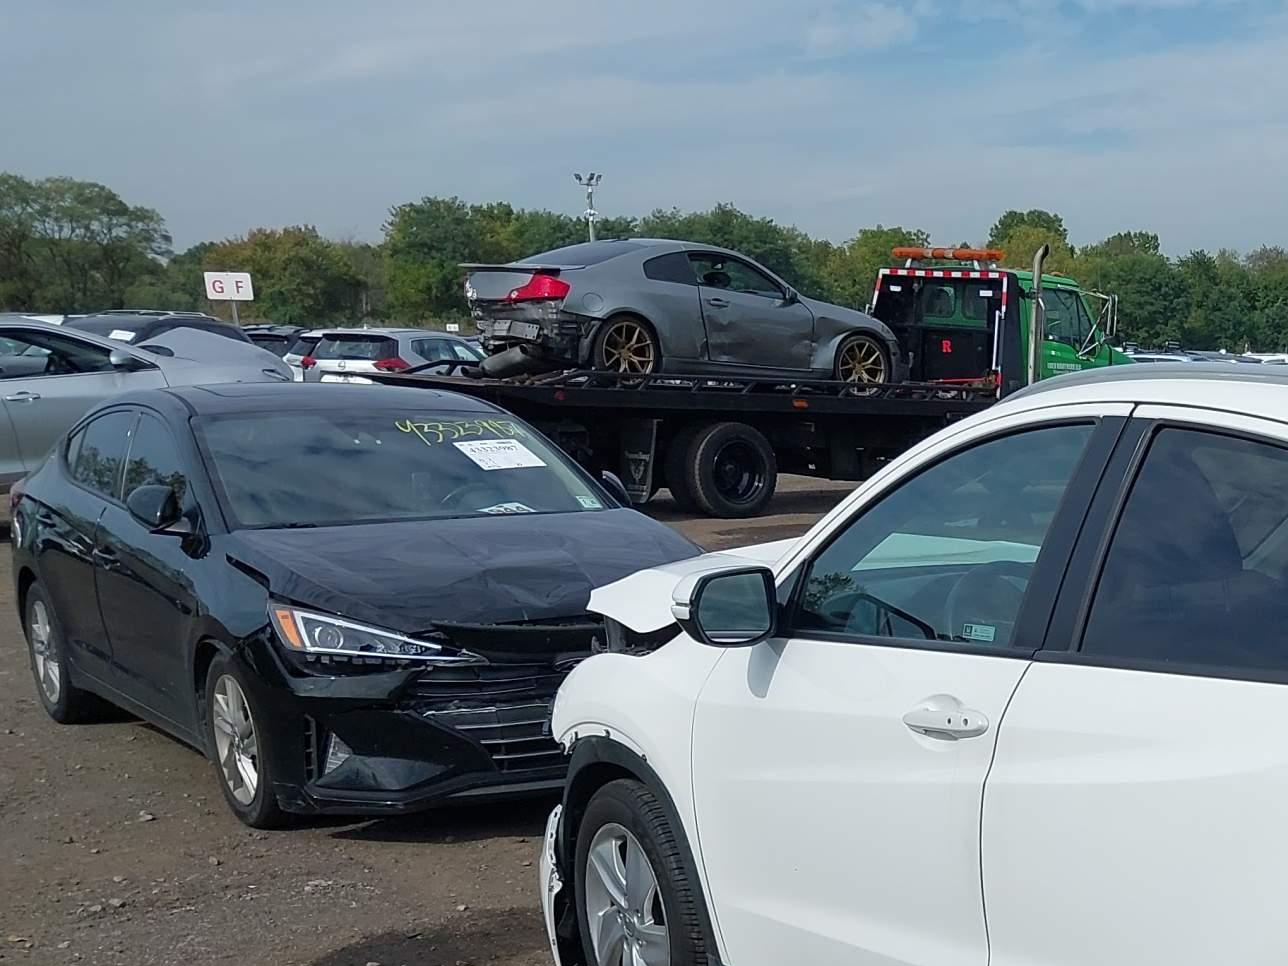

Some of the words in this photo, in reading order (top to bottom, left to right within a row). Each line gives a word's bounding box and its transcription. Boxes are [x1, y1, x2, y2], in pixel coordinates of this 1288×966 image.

[212, 279, 225, 294] G
[235, 280, 244, 294] F
[942, 340, 952, 353] R
